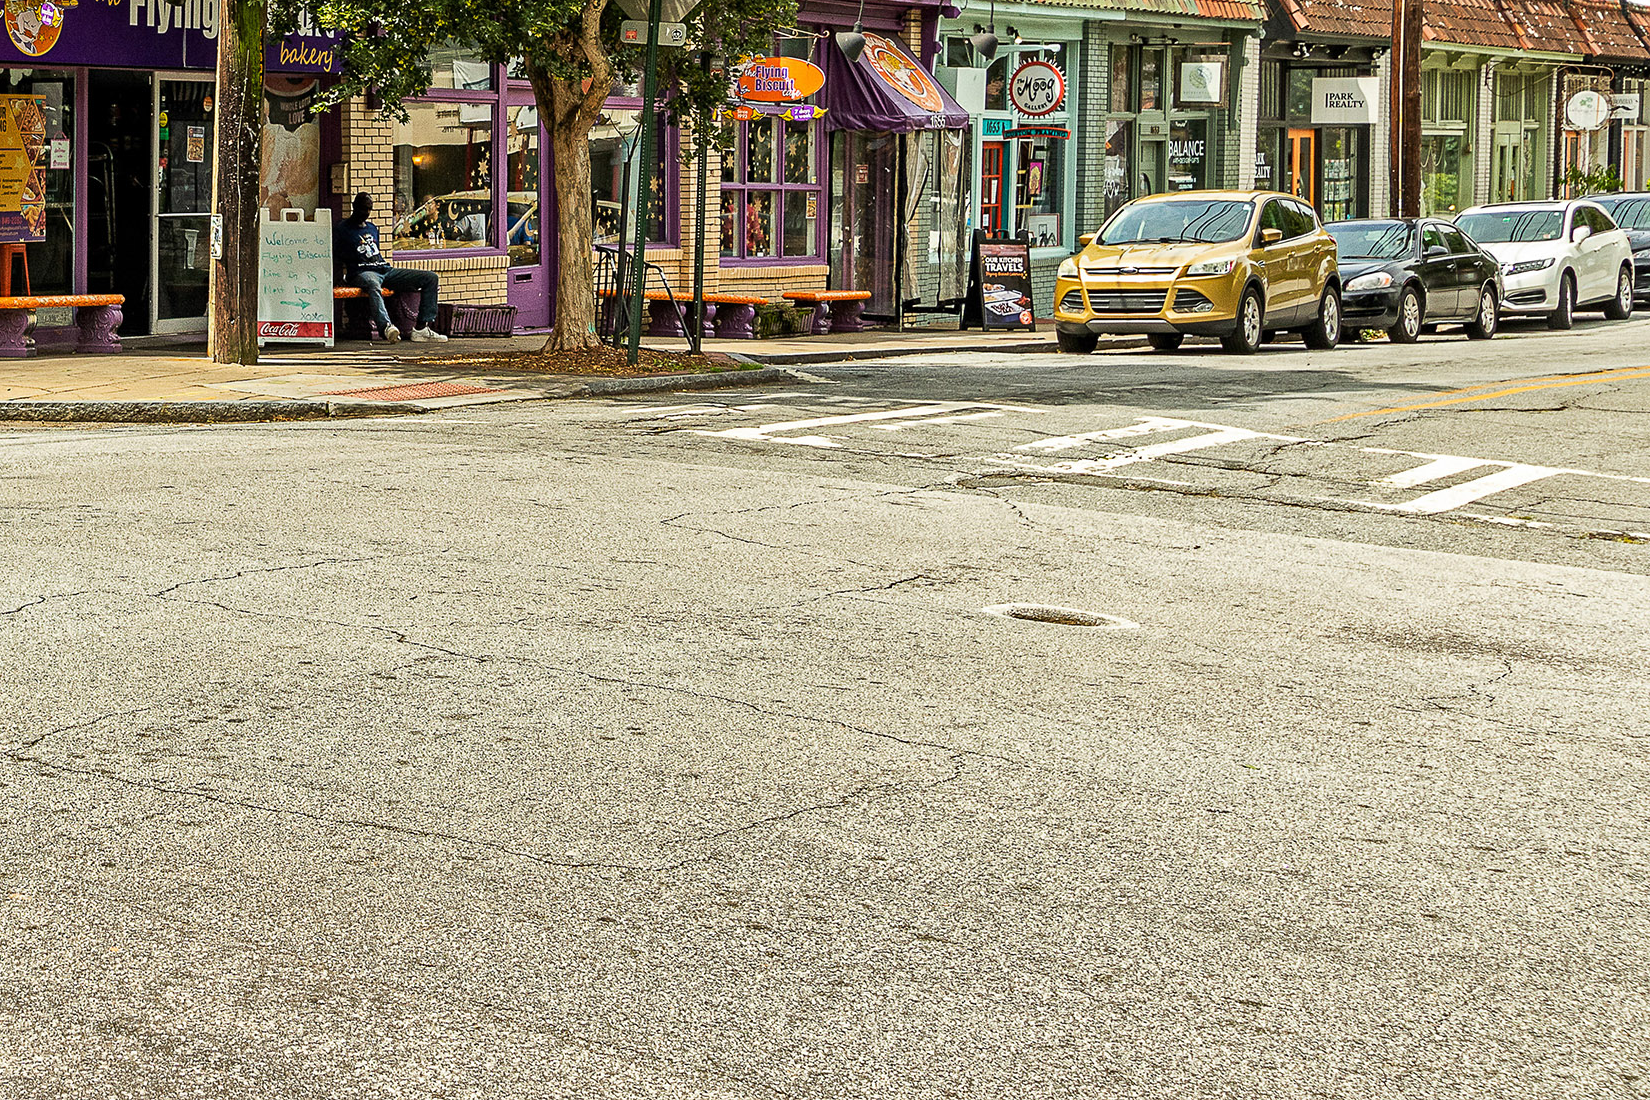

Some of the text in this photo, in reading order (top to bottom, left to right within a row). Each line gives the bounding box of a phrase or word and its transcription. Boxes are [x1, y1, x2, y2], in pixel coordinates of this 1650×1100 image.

[280, 41, 333, 72] bakery
[755, 65, 789, 79] Flying
[755, 77, 795, 91] Biscuit
[1017, 76, 1055, 103] Moog
[1024, 102, 1048, 110] GALLERY
[1329, 100, 1364, 108] REALTY
[288, 110, 305, 124] LOVE
[930, 115, 947, 128] 1655
[1169, 141, 1204, 156] BALANCE
[265, 231, 325, 246] Welcome to
[261, 249, 331, 264] Flying Biscuit
[984, 263, 1024, 272] TRAVELS
